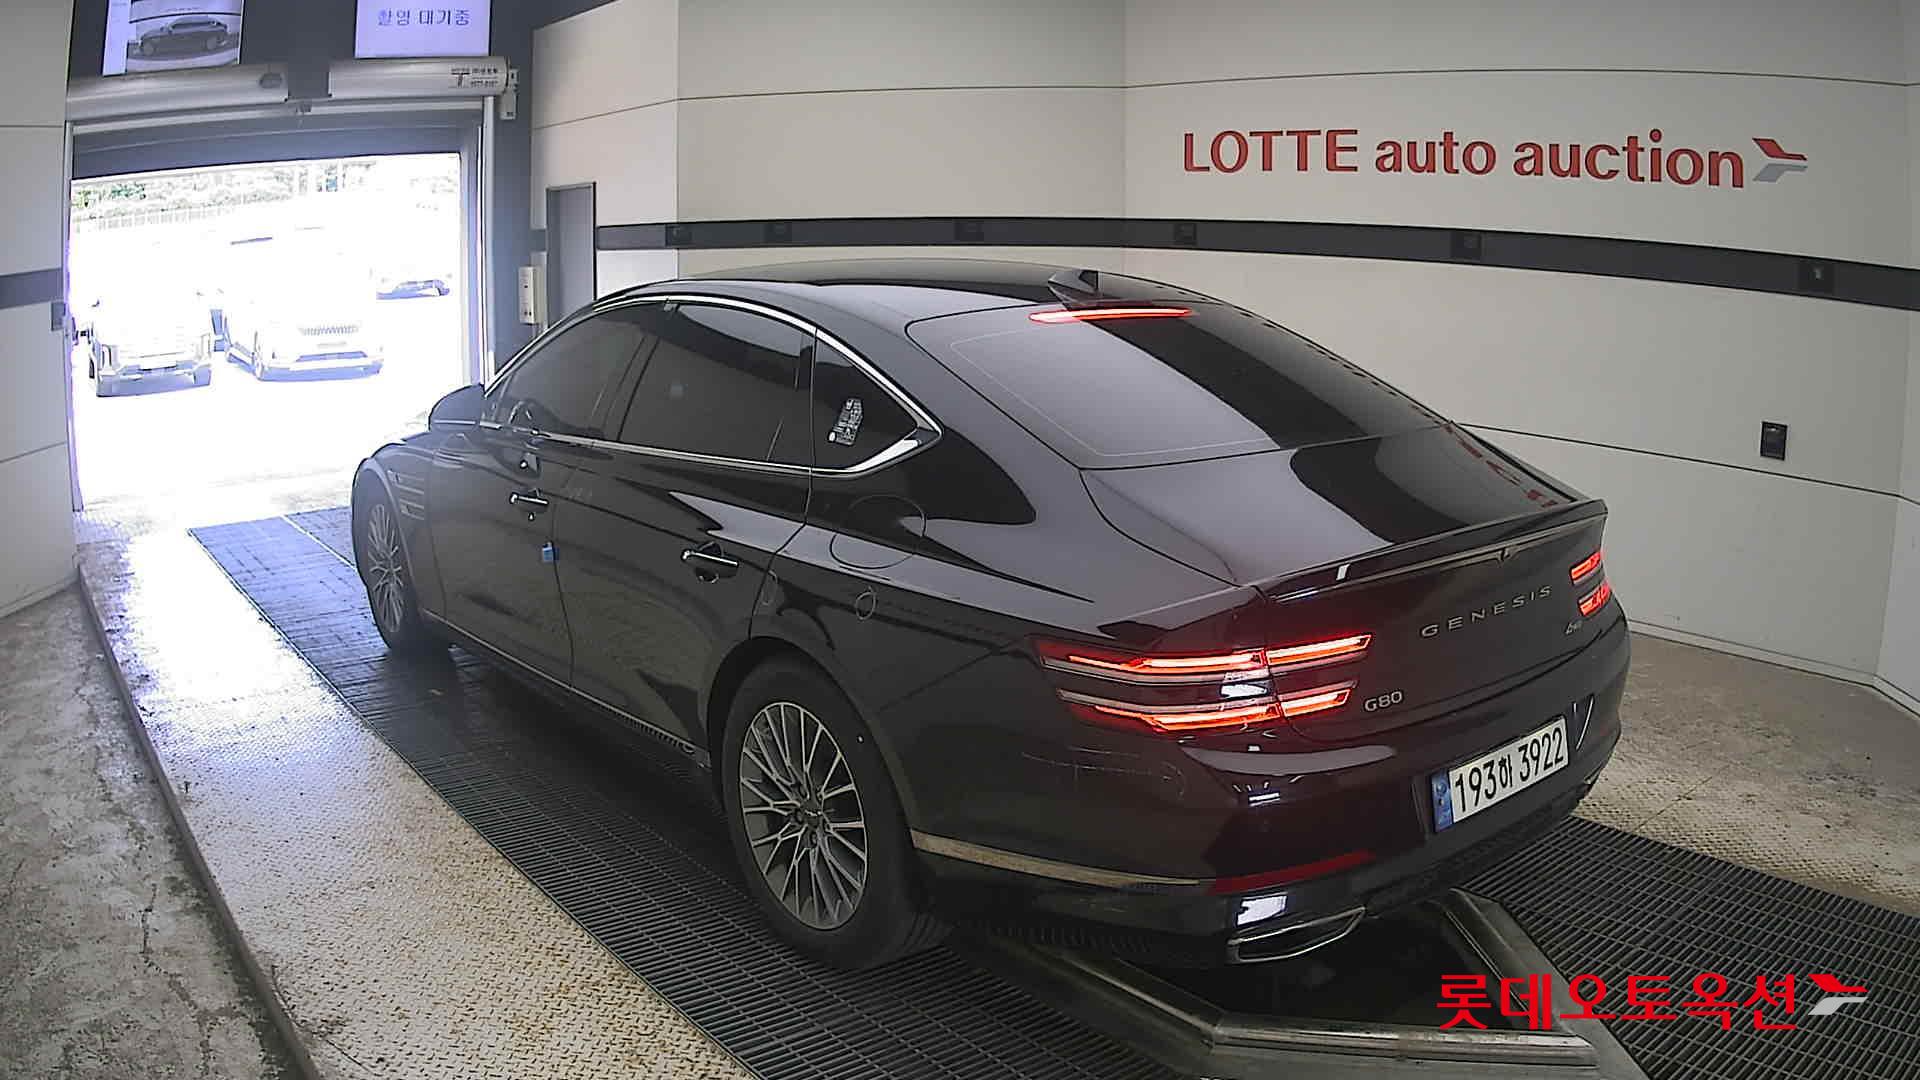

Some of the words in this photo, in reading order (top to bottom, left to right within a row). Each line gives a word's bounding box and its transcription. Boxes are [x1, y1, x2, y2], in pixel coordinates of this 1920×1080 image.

[419, 9, 471, 26] 대기중
[1184, 129, 1358, 172] LOTTE
[1375, 131, 1497, 175] auto
[1513, 129, 1745, 188] auction
[1421, 586, 1551, 637] GENESIS
[1364, 690, 1403, 712] G80
[1455, 754, 1513, 812] 193하
[1518, 728, 1564, 782] 3922
